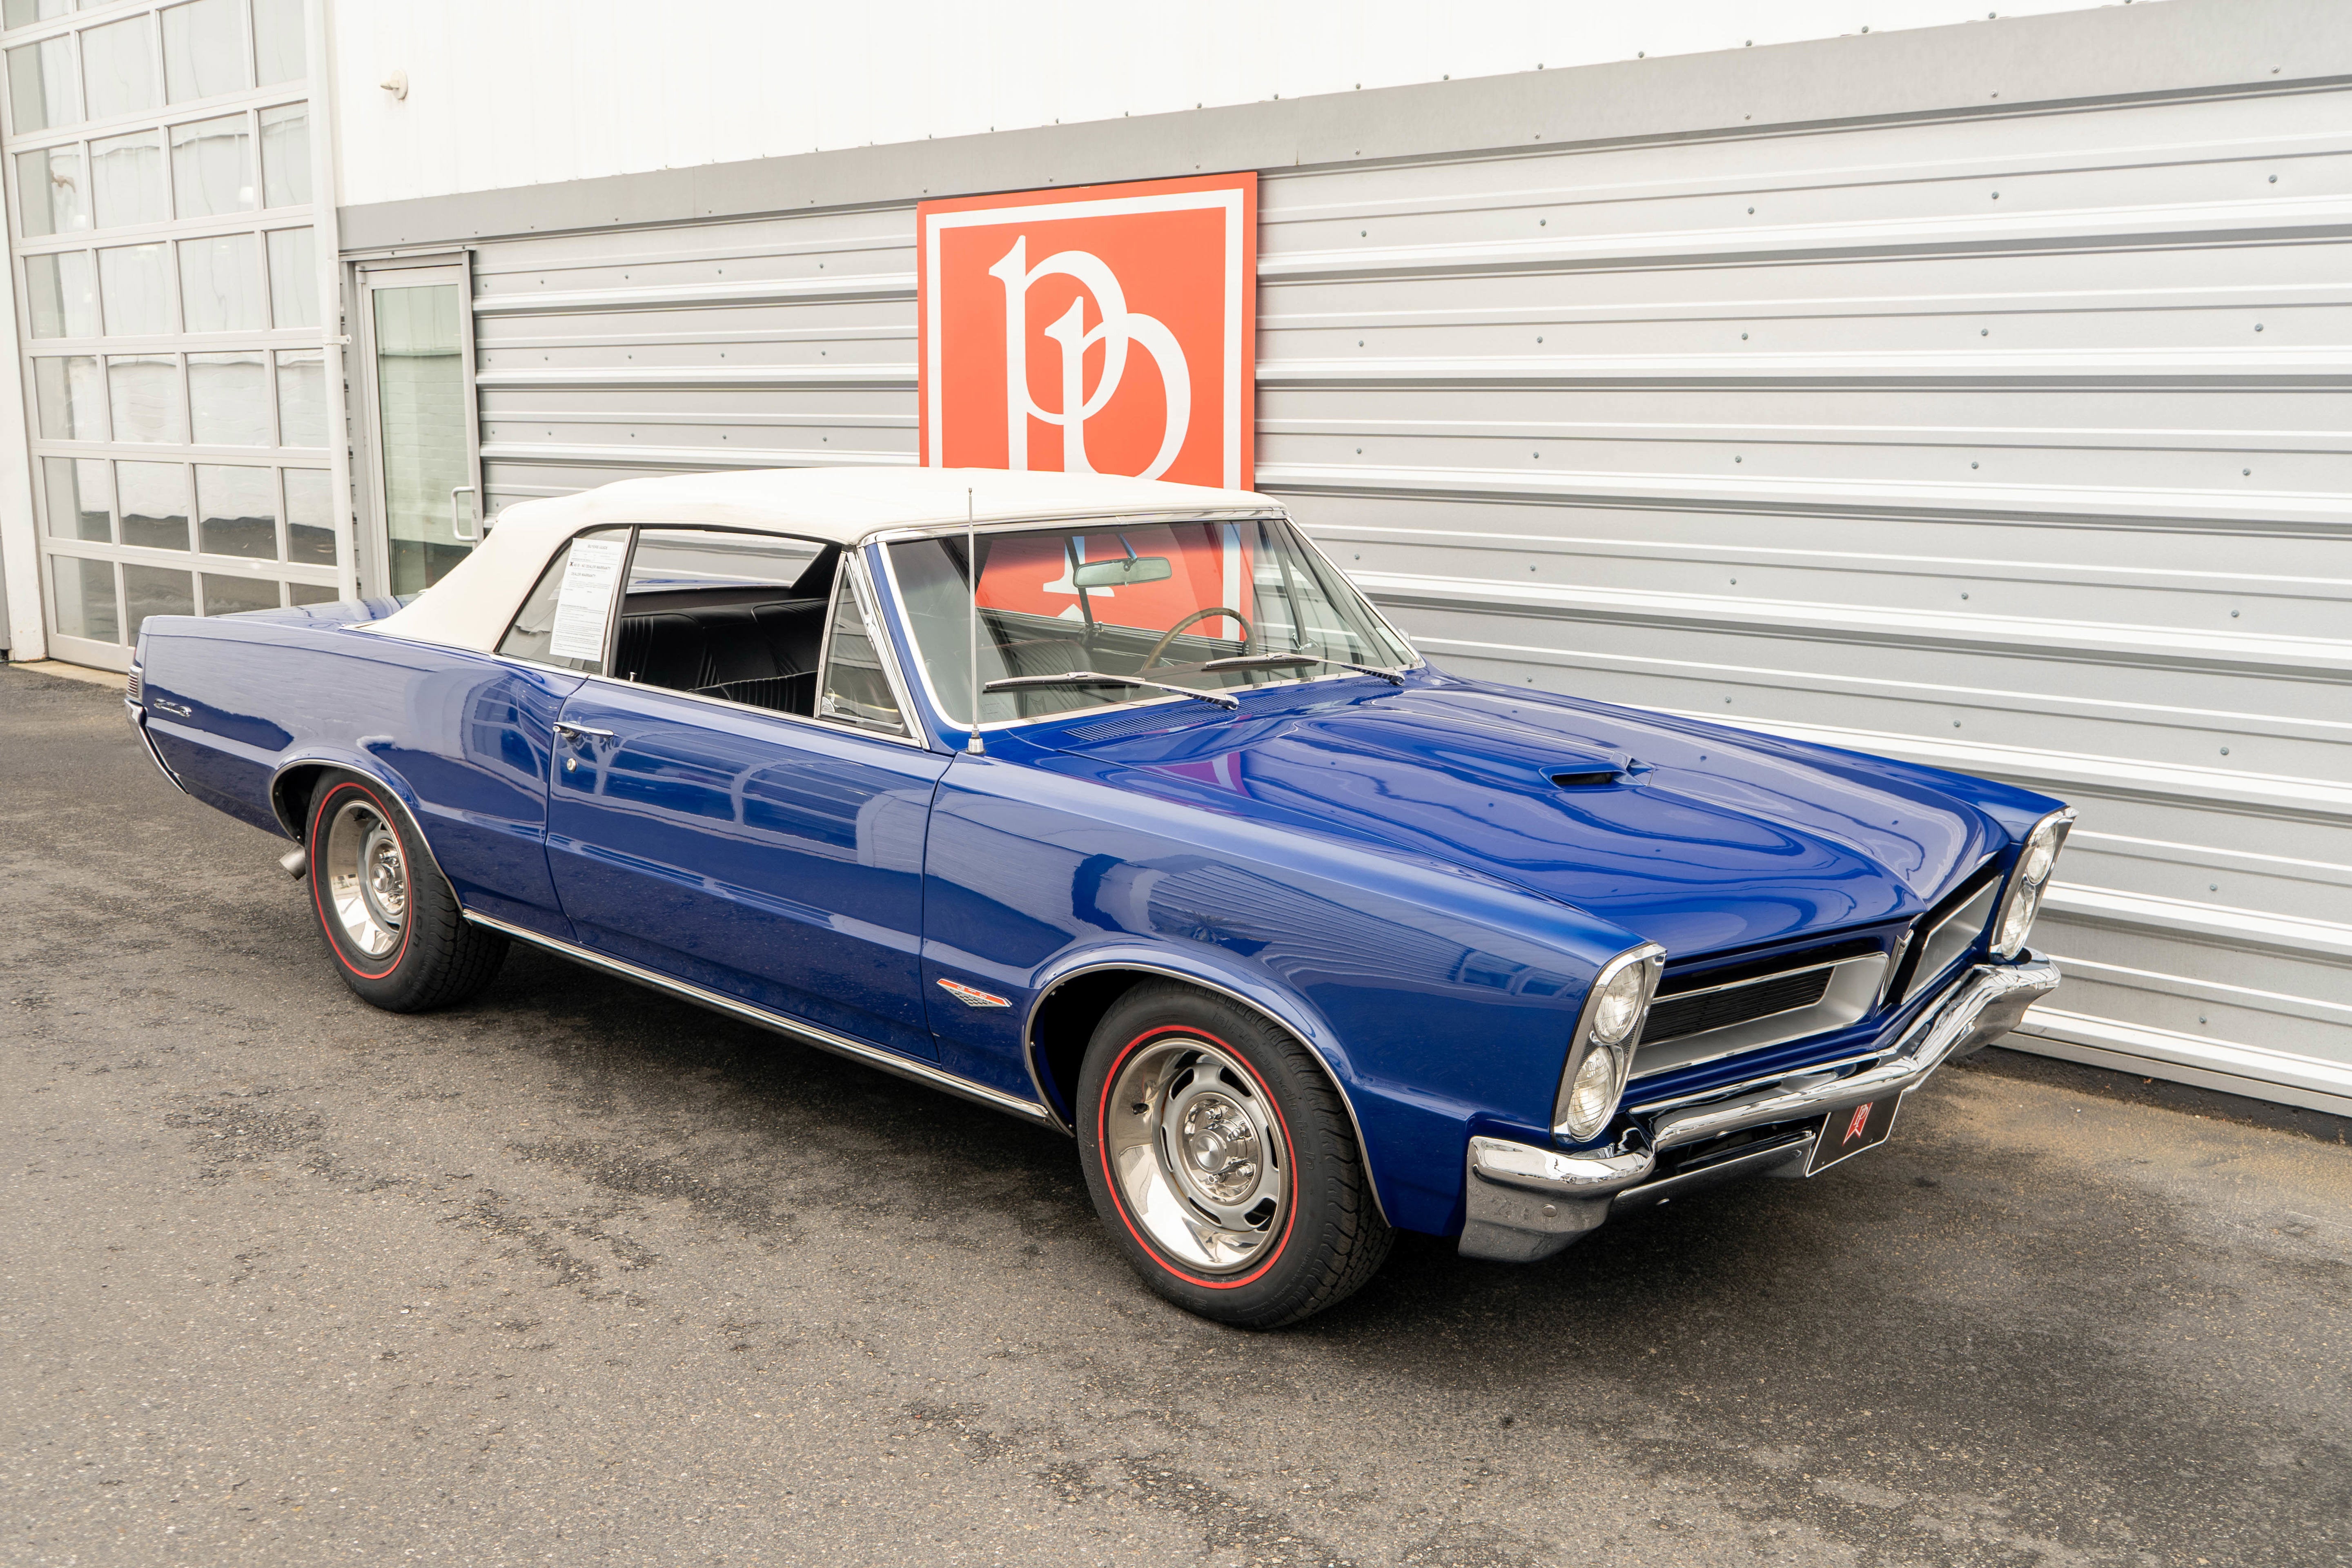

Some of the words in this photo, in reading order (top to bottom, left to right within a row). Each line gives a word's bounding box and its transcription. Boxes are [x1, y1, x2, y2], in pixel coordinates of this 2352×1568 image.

[153, 698, 193, 718] GTO
[957, 986, 987, 999] GTO
[1212, 1012, 1316, 1171] BFGoodrich
